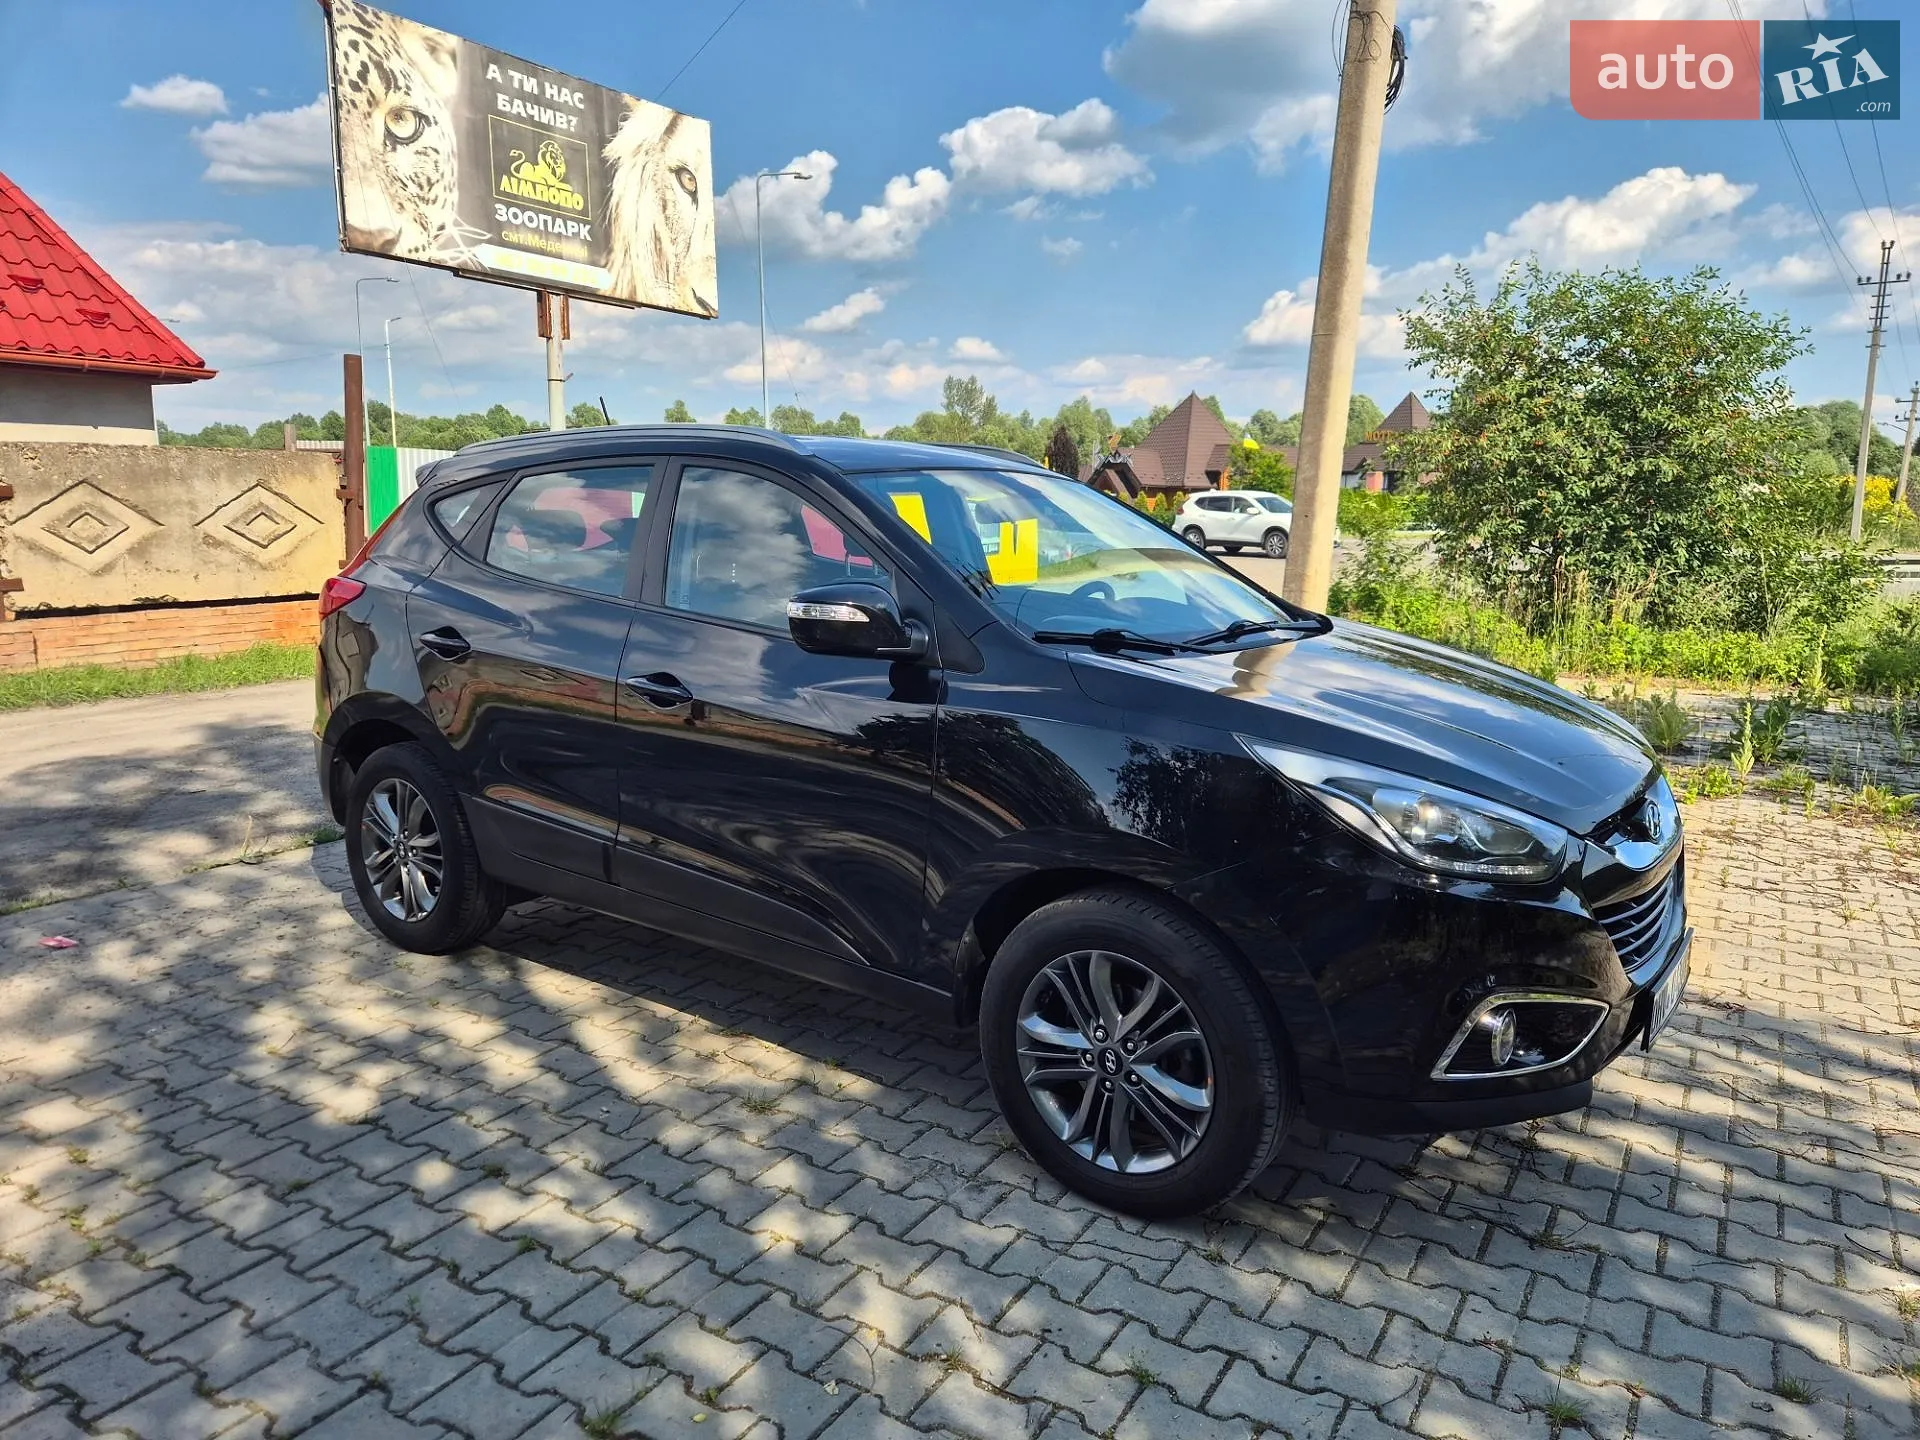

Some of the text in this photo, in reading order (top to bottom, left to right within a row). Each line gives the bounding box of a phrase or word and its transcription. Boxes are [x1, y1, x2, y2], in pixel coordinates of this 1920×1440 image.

[485, 63, 585, 110] А ТИ НАС
[496, 92, 579, 132] БАЧИВ?
[499, 174, 585, 211] ЛІМПОПО
[494, 203, 593, 242] ЗООПАРК
